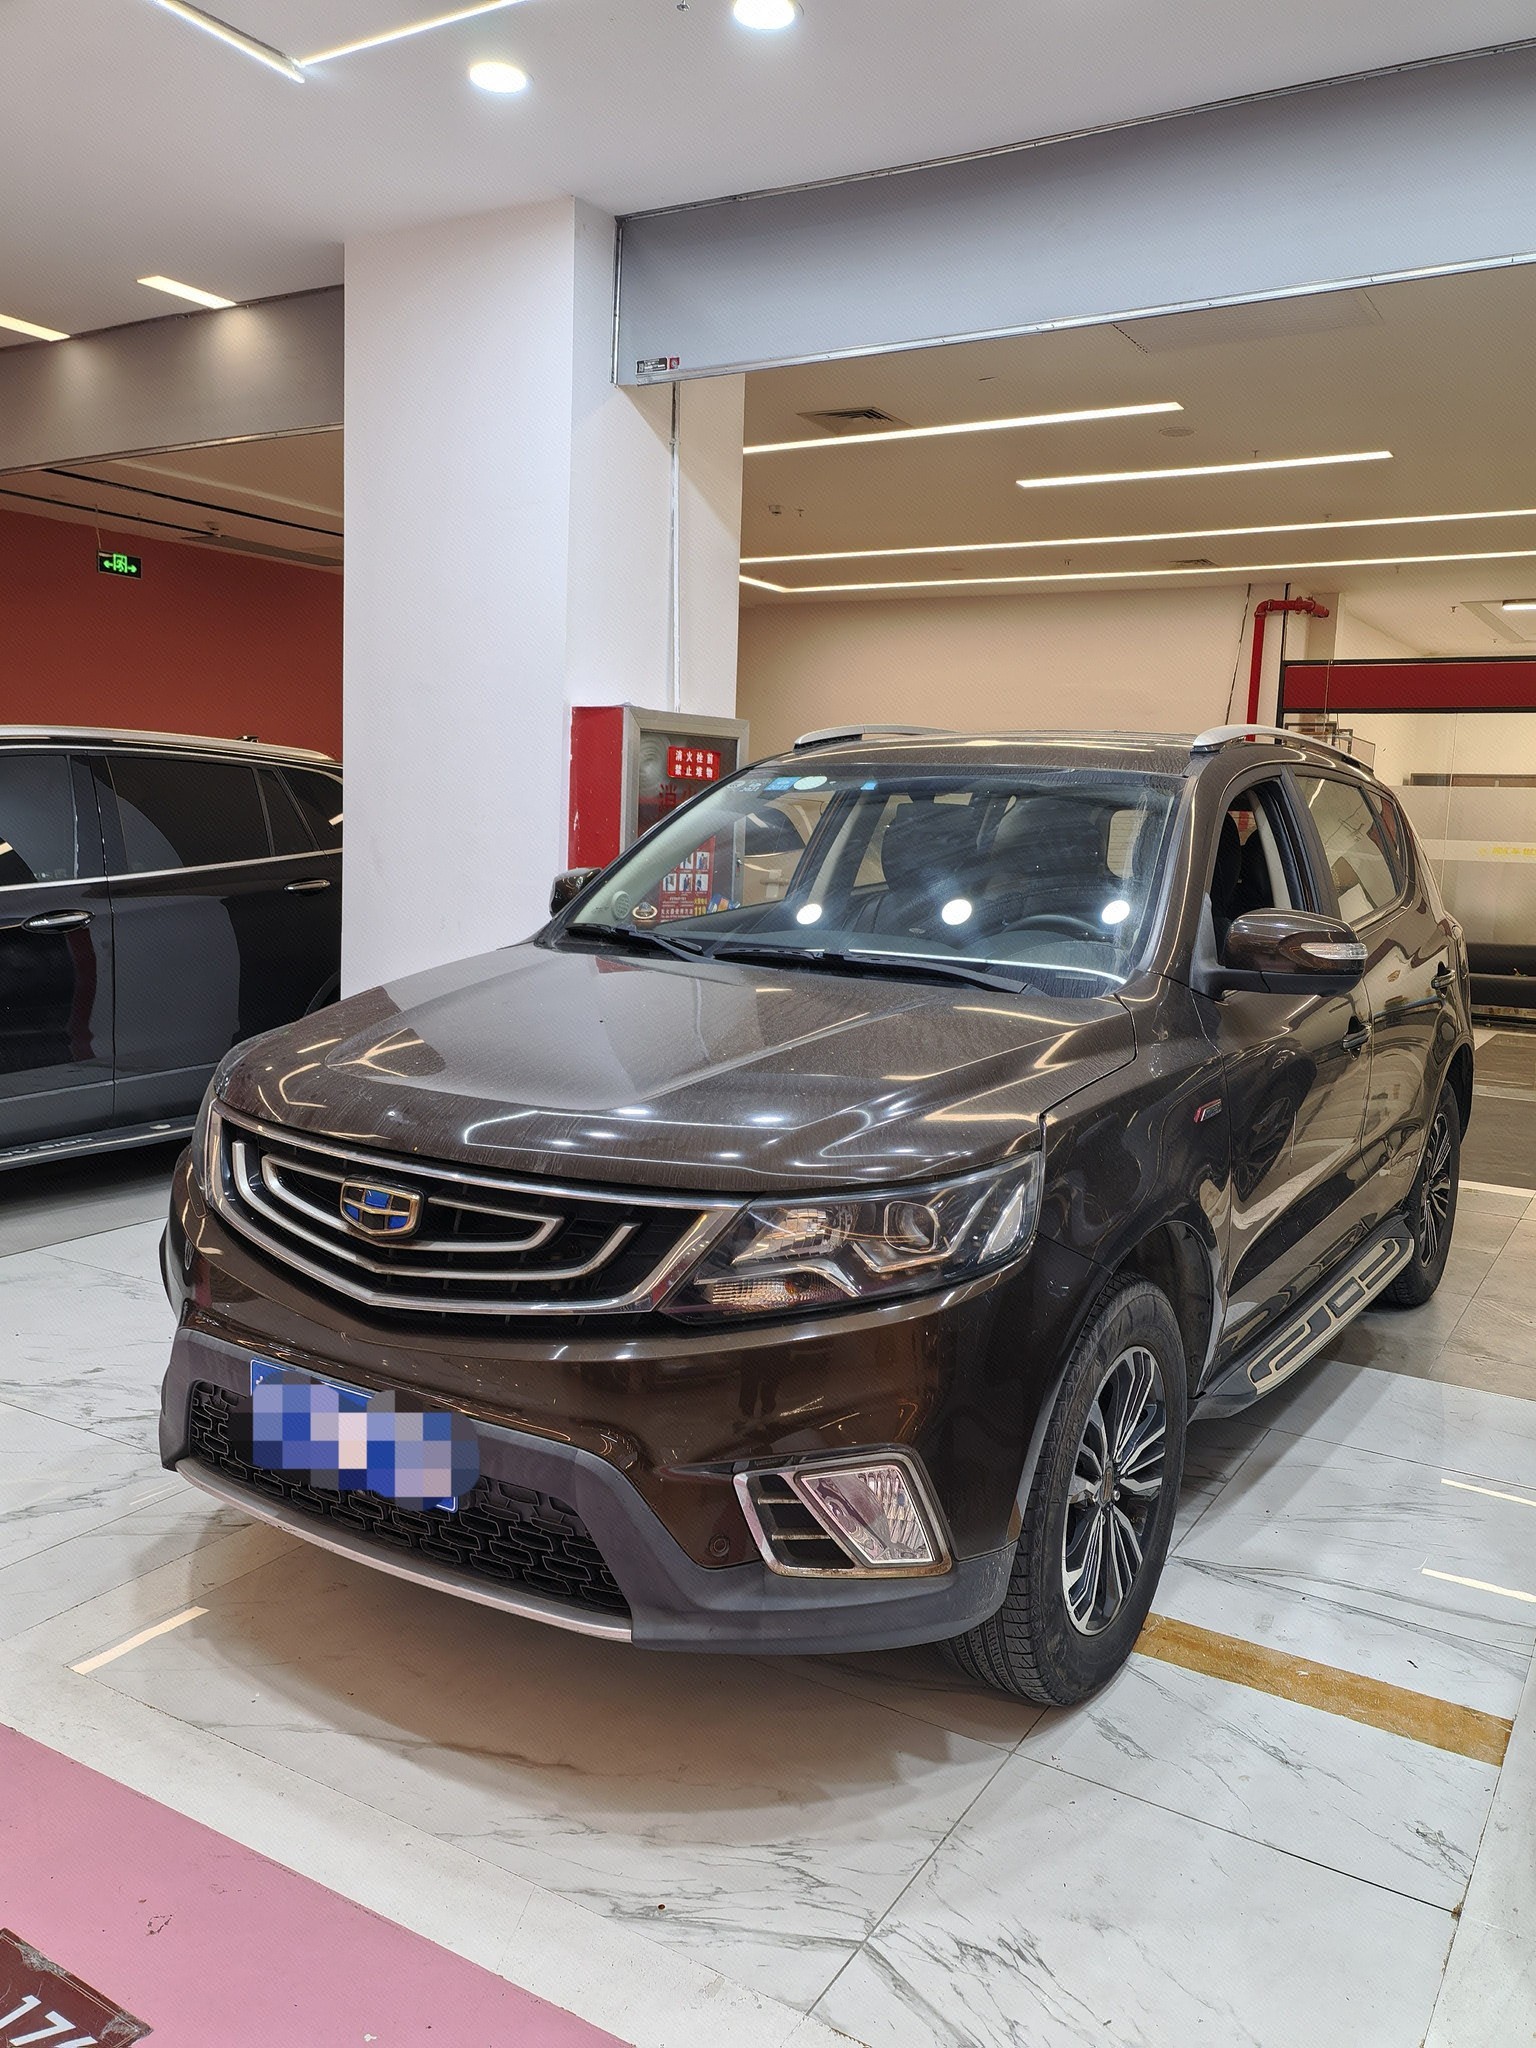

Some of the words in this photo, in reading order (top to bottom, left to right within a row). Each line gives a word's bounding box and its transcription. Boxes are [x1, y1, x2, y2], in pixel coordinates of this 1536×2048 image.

[675, 749, 714, 765] 消火栓前
[674, 764, 713, 779] 禁止堆物
